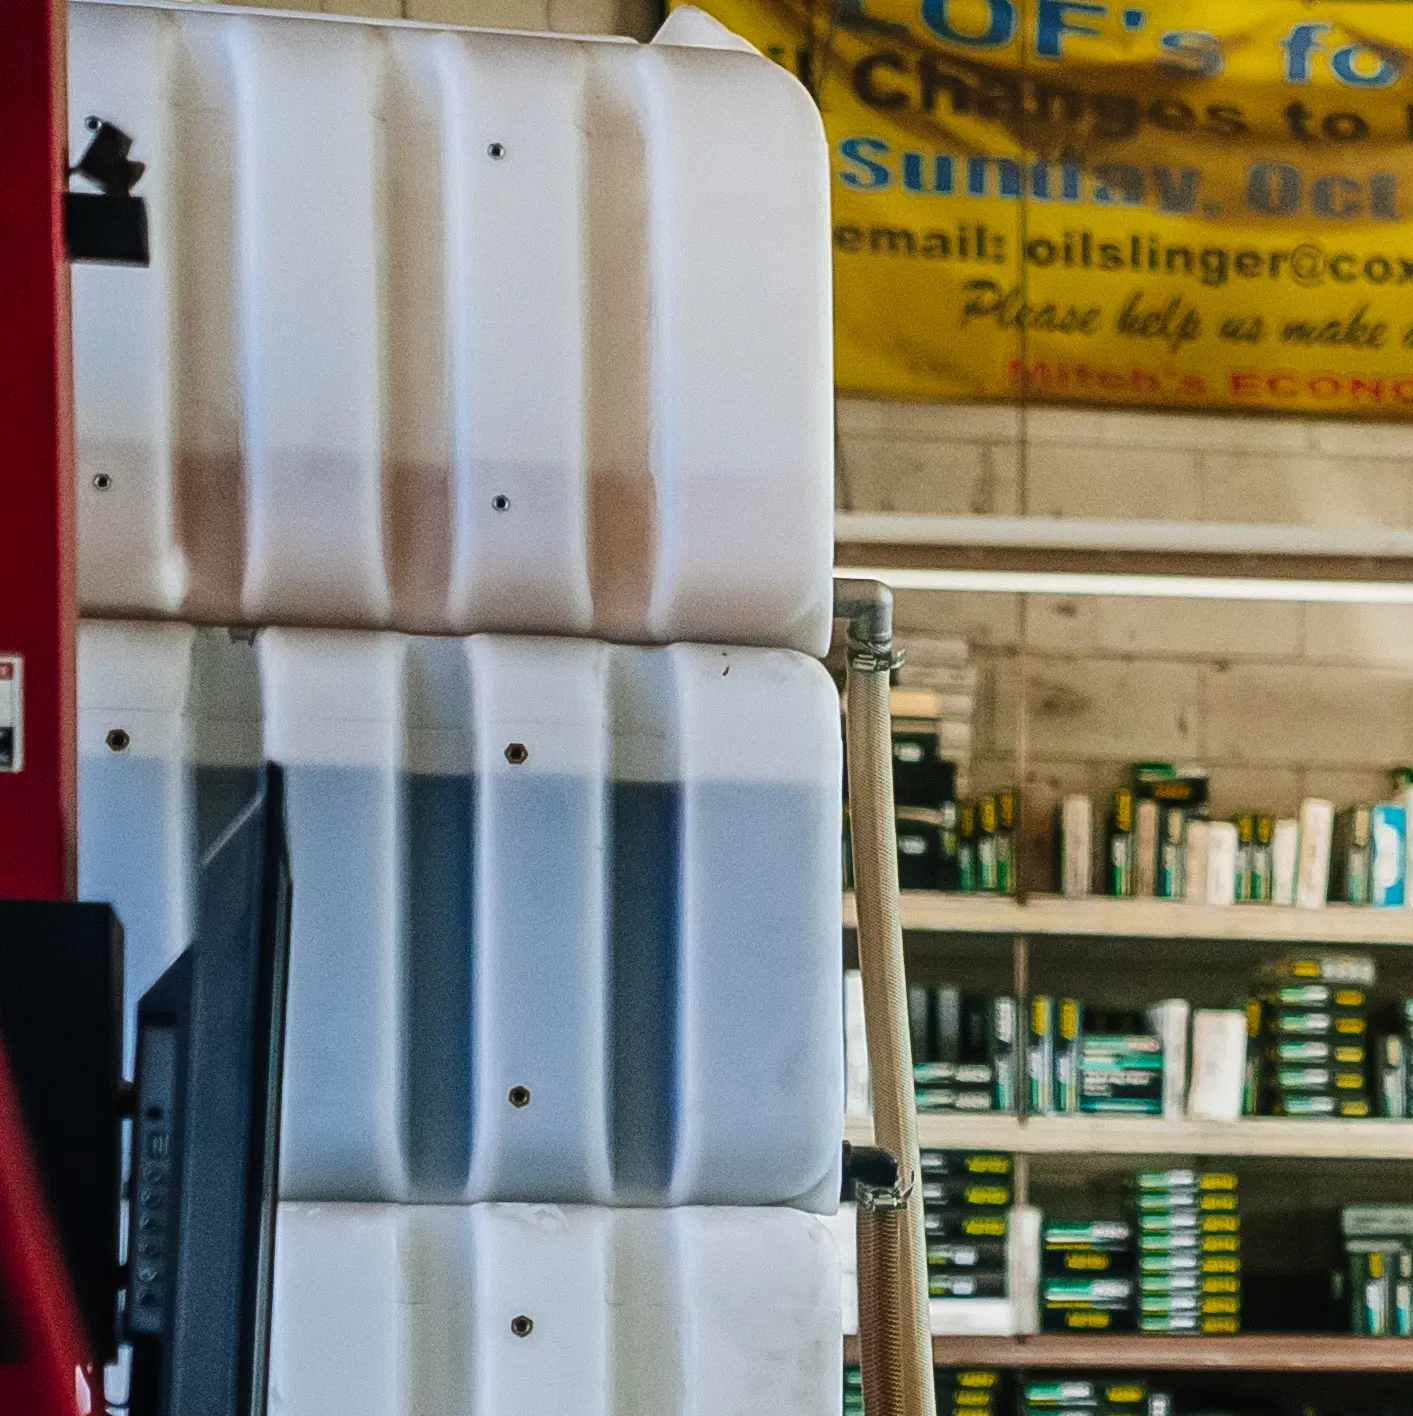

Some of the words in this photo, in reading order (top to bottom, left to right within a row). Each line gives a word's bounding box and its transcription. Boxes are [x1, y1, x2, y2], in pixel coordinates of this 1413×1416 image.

[850, 50, 1250, 142] Changes
[1283, 103, 1371, 143] to
[1244, 163, 1400, 222] Oct
[959, 278, 1104, 335] Please
[1116, 289, 1203, 353] help
[1218, 315, 1266, 344] us
[1280, 300, 1389, 350] make
